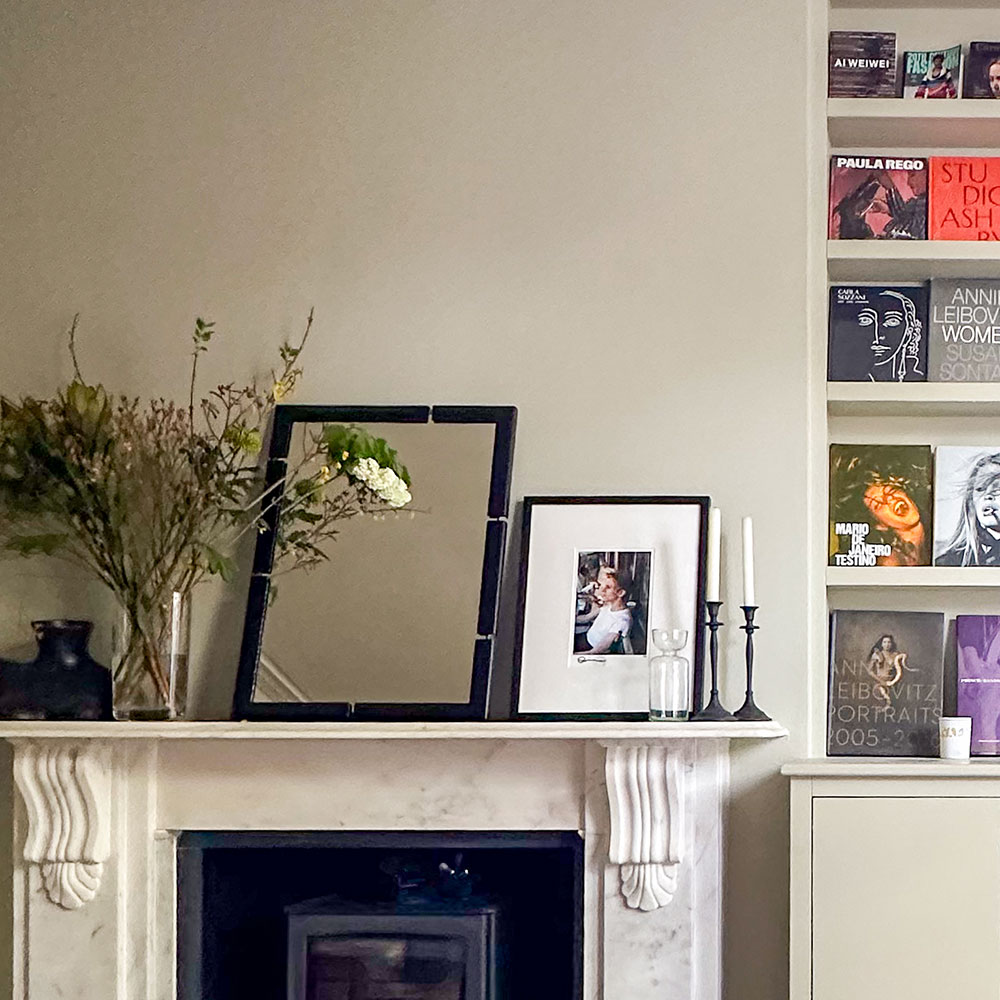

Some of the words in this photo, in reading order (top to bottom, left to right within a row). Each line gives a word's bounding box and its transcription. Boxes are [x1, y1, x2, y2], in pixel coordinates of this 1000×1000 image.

[834, 58, 848, 68] AI
[848, 58, 890, 68] WEIWEI
[837, 158, 884, 169] PAULA
[886, 160, 924, 170] REGO
[941, 162, 988, 183] STU
[940, 208, 993, 228] ASH
[835, 522, 870, 536] MARIO
[852, 535, 864, 545] DE
[849, 544, 892, 557] JANEIRO
[835, 555, 877, 566] TESTINO
